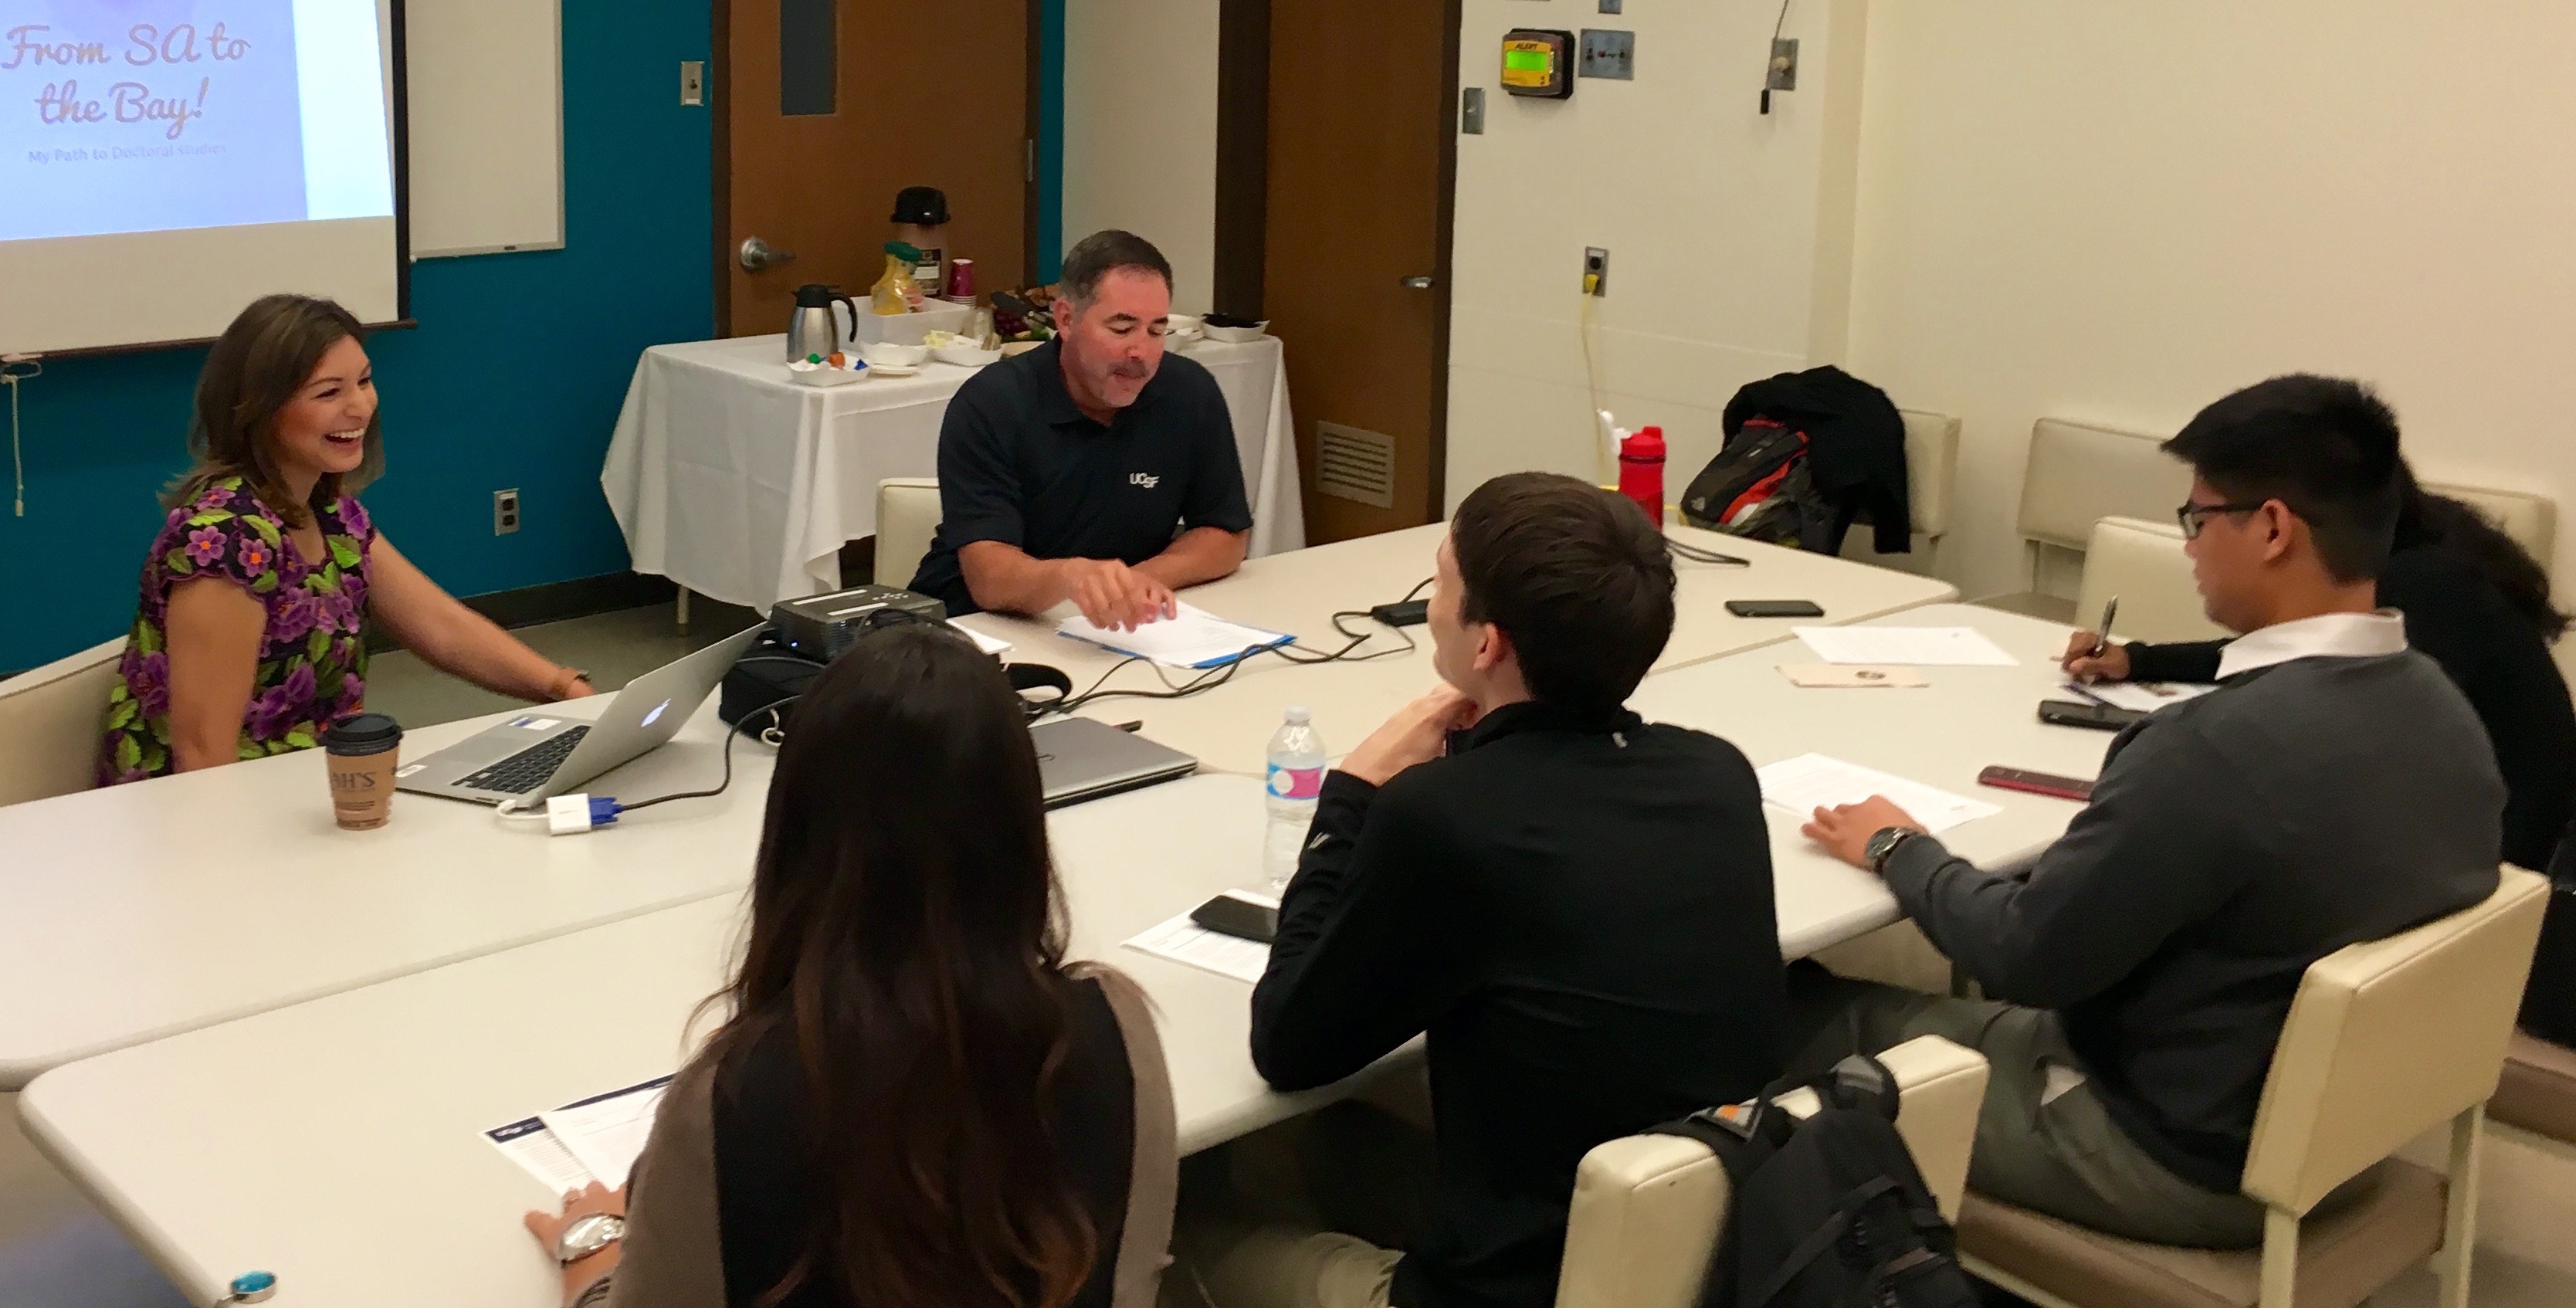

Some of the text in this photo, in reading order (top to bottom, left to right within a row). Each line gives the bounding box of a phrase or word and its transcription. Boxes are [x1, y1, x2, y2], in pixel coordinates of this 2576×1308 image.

[1, 22, 251, 69] From SA to
[34, 76, 210, 140] the Bay!
[29, 150, 49, 164] My
[54, 147, 88, 161] Path
[93, 147, 108, 160] to
[112, 143, 174, 159] Doctoral
